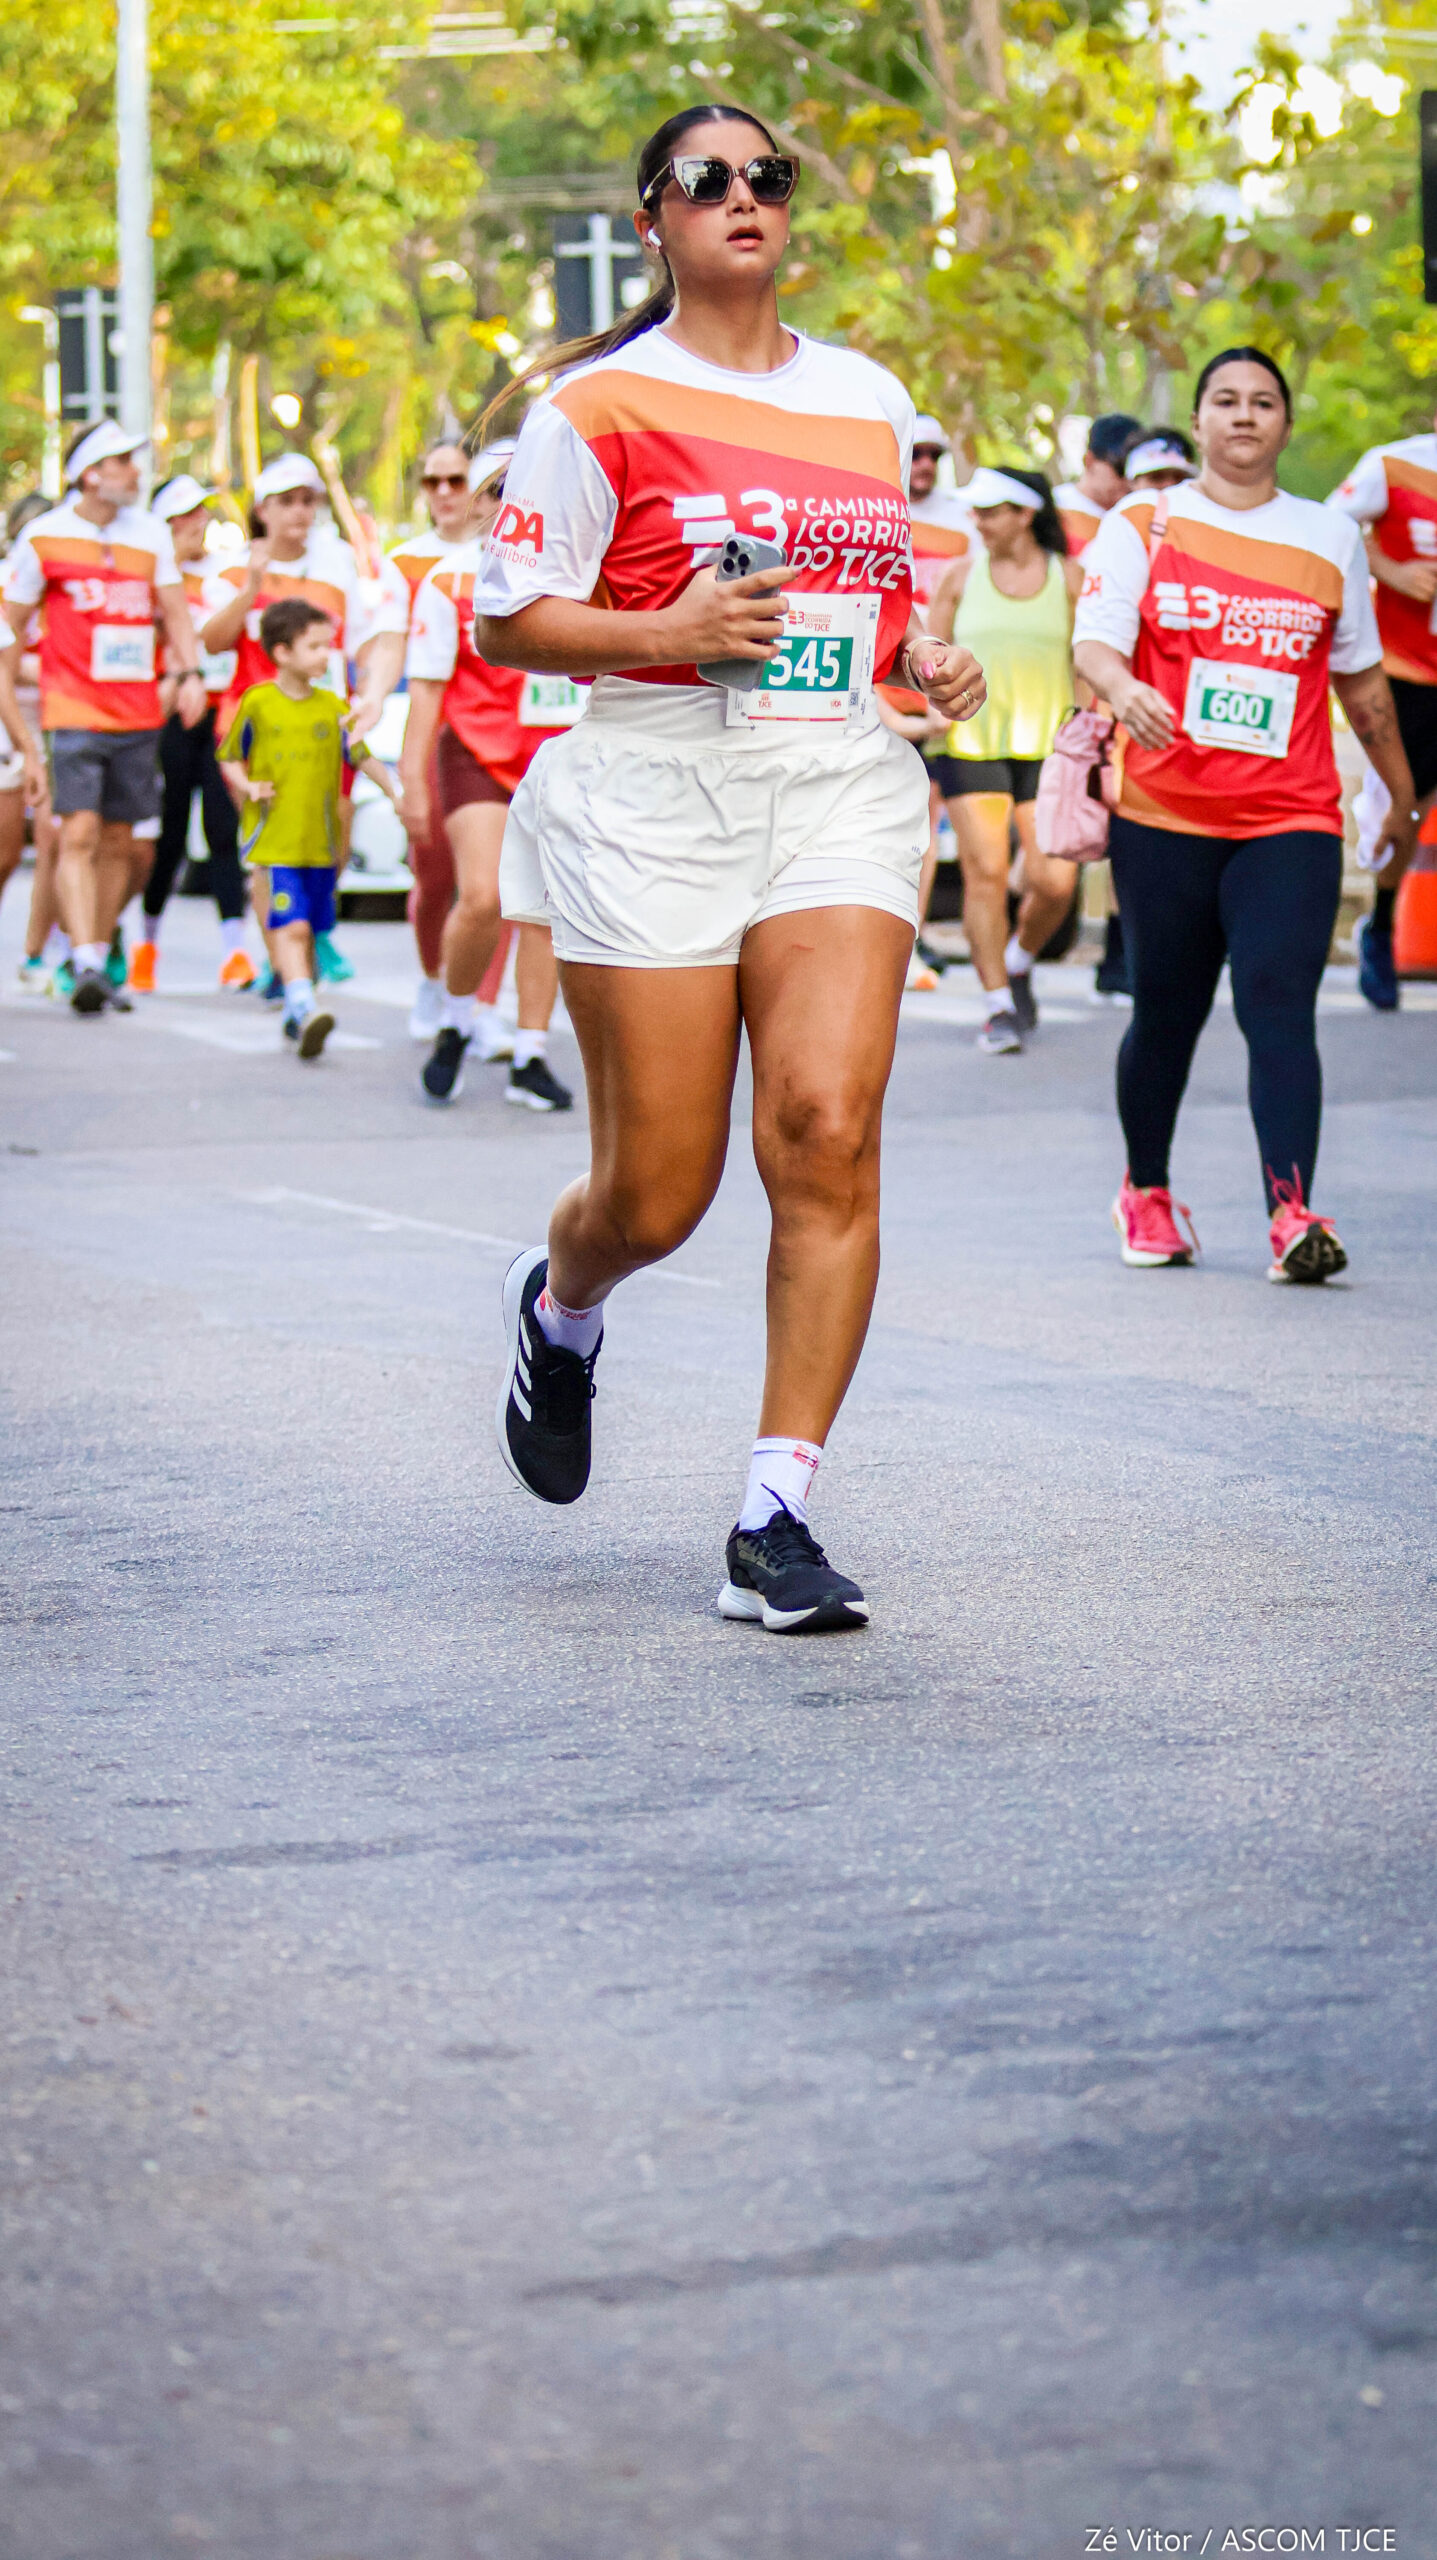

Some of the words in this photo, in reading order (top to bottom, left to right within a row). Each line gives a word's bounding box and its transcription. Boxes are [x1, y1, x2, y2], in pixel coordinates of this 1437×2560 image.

[789, 545, 834, 572] DO
[836, 548, 910, 590] TJCE
[814, 624, 830, 632] TJCE
[1222, 624, 1257, 647] DO
[768, 639, 841, 687] 545
[1209, 690, 1265, 726] 600
